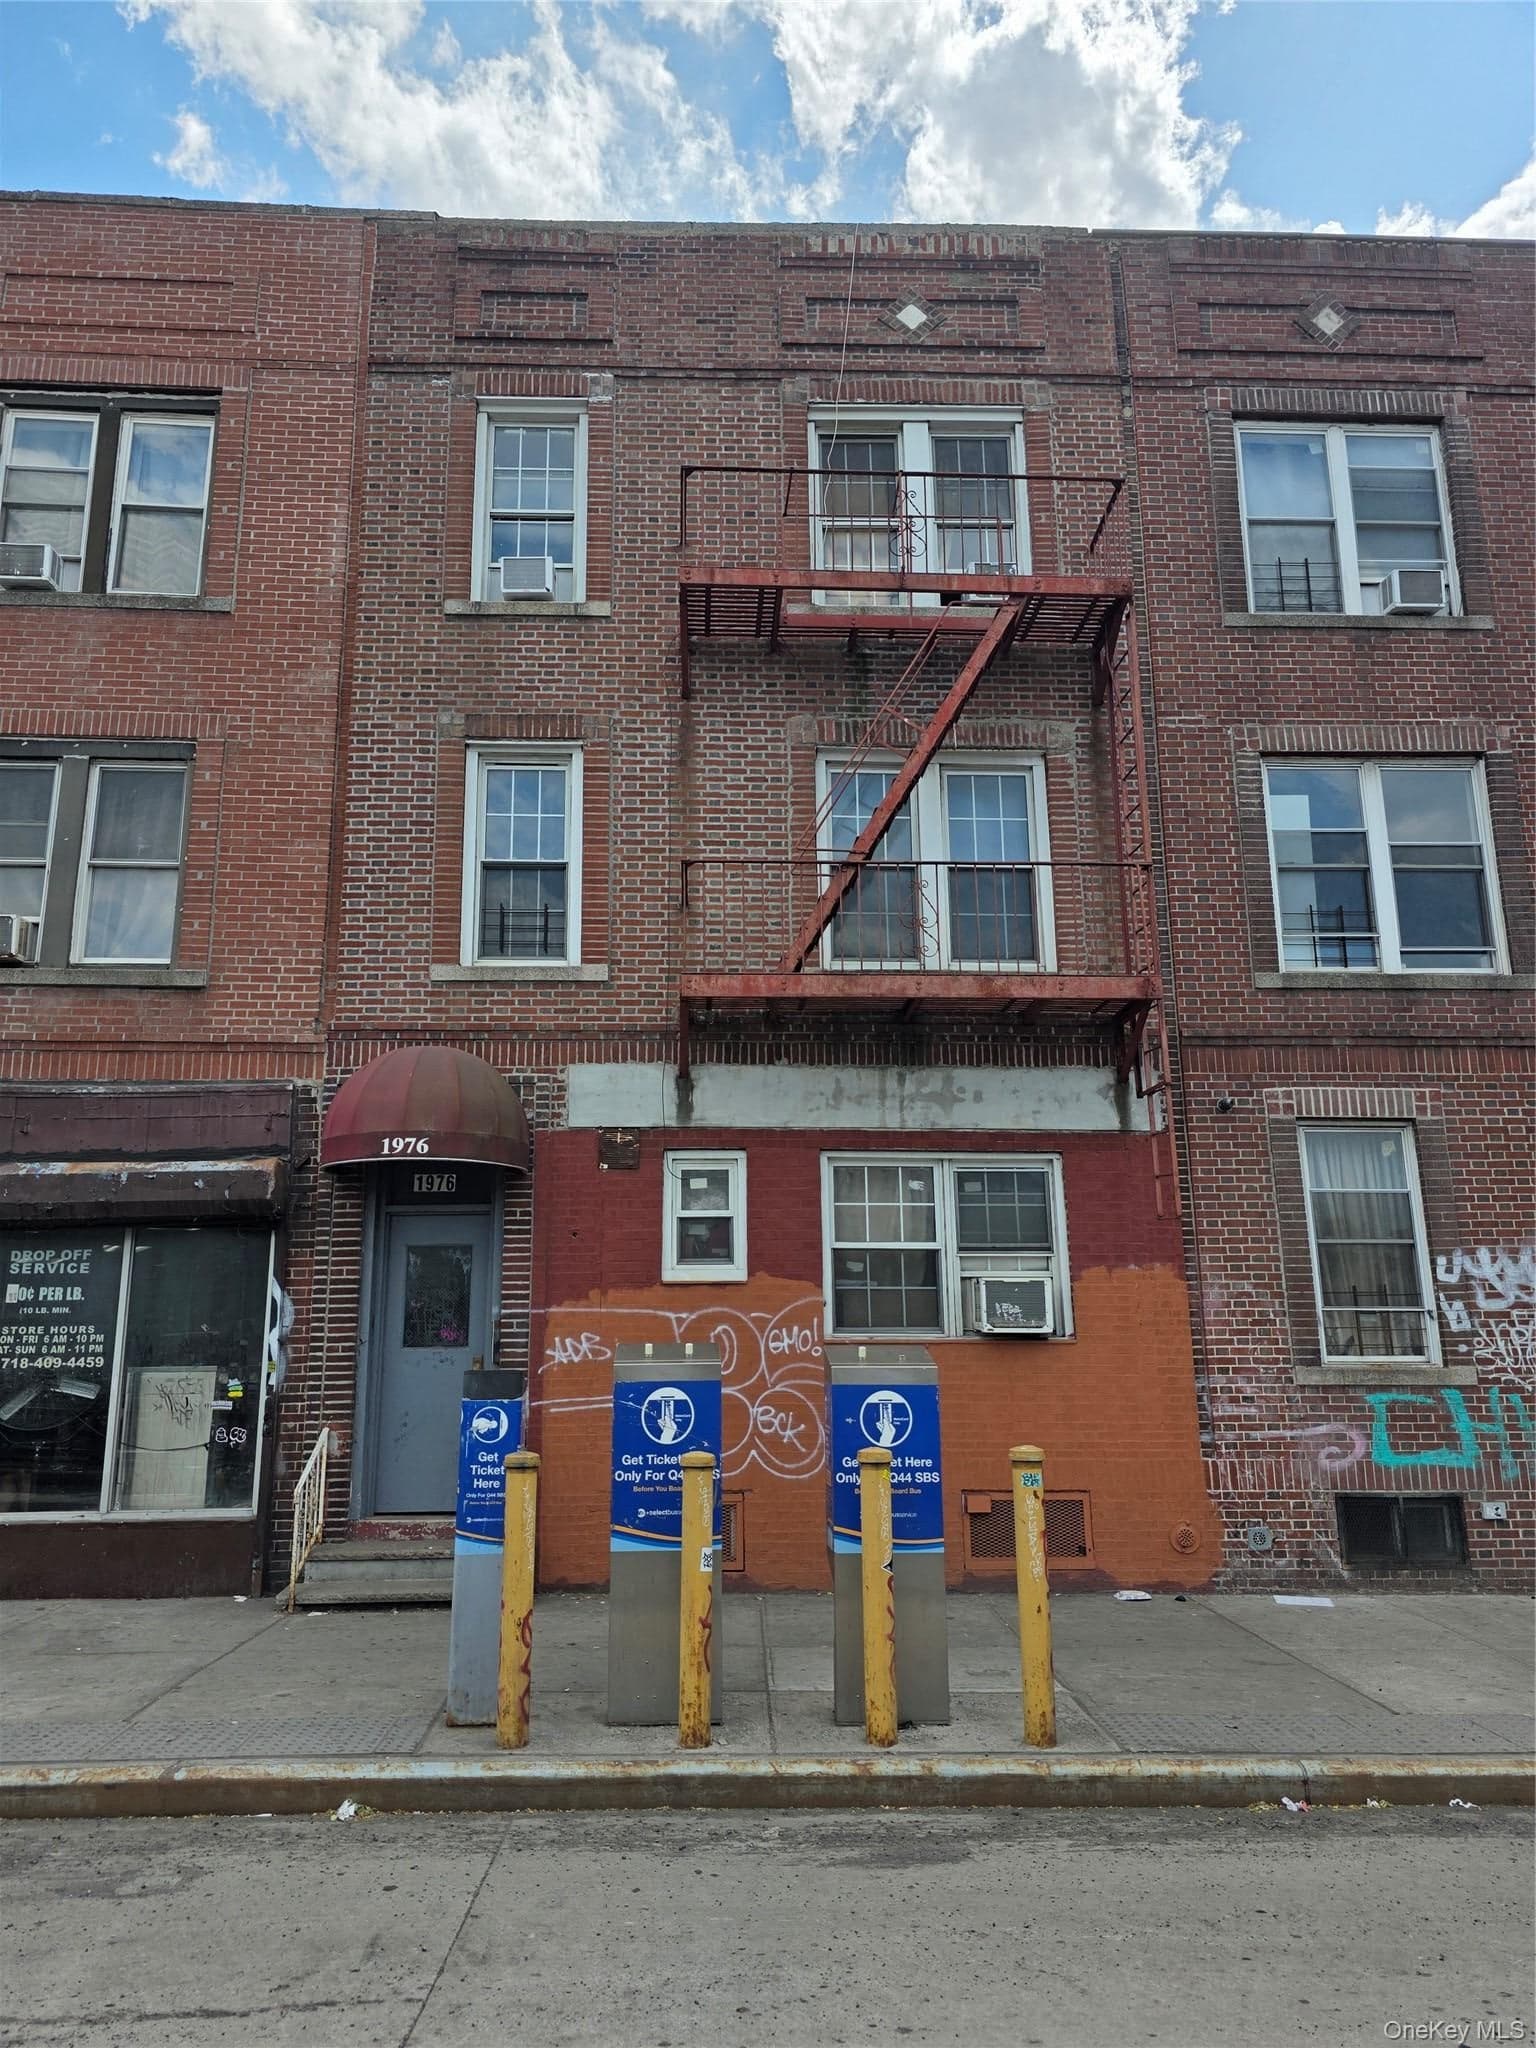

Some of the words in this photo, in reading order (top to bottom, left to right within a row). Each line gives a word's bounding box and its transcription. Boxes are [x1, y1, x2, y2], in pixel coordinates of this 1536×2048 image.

[381, 1137, 430, 1154] 1976
[415, 1175, 455, 1191] 1976
[11, 1250, 55, 1262] DROP
[61, 1249, 92, 1260] OFF
[9, 1263, 90, 1274] SERVICE
[39, 1287, 63, 1301] PER
[66, 1287, 85, 1301] LB.
[2, 1326, 45, 1334] STORE
[50, 1325, 96, 1334] HOURS
[0, 1336, 14, 1344] ON
[43, 1335, 50, 1343] 6
[52, 1335, 67, 1343] AM
[76, 1335, 87, 1343] 10
[90, 1334, 105, 1342] PM
[15, 1346, 36, 1354] SUN
[41, 1345, 48, 1353] 6
[50, 1345, 66, 1353] AM
[75, 1345, 85, 1353] 11
[88, 1345, 103, 1353] PM
[2, 1356, 105, 1369] 718-409-4459
[478, 1452, 499, 1463] Get
[622, 1454, 644, 1466] Get
[842, 1457, 859, 1468] Ge
[905, 1456, 933, 1468] Here
[470, 1464, 505, 1475] Ticket
[614, 1470, 642, 1483] Only
[644, 1470, 665, 1481] For
[667, 1469, 684, 1481] Q4
[889, 1472, 912, 1484] Q44
[915, 1472, 940, 1484] SBS
[473, 1478, 501, 1489] Here
